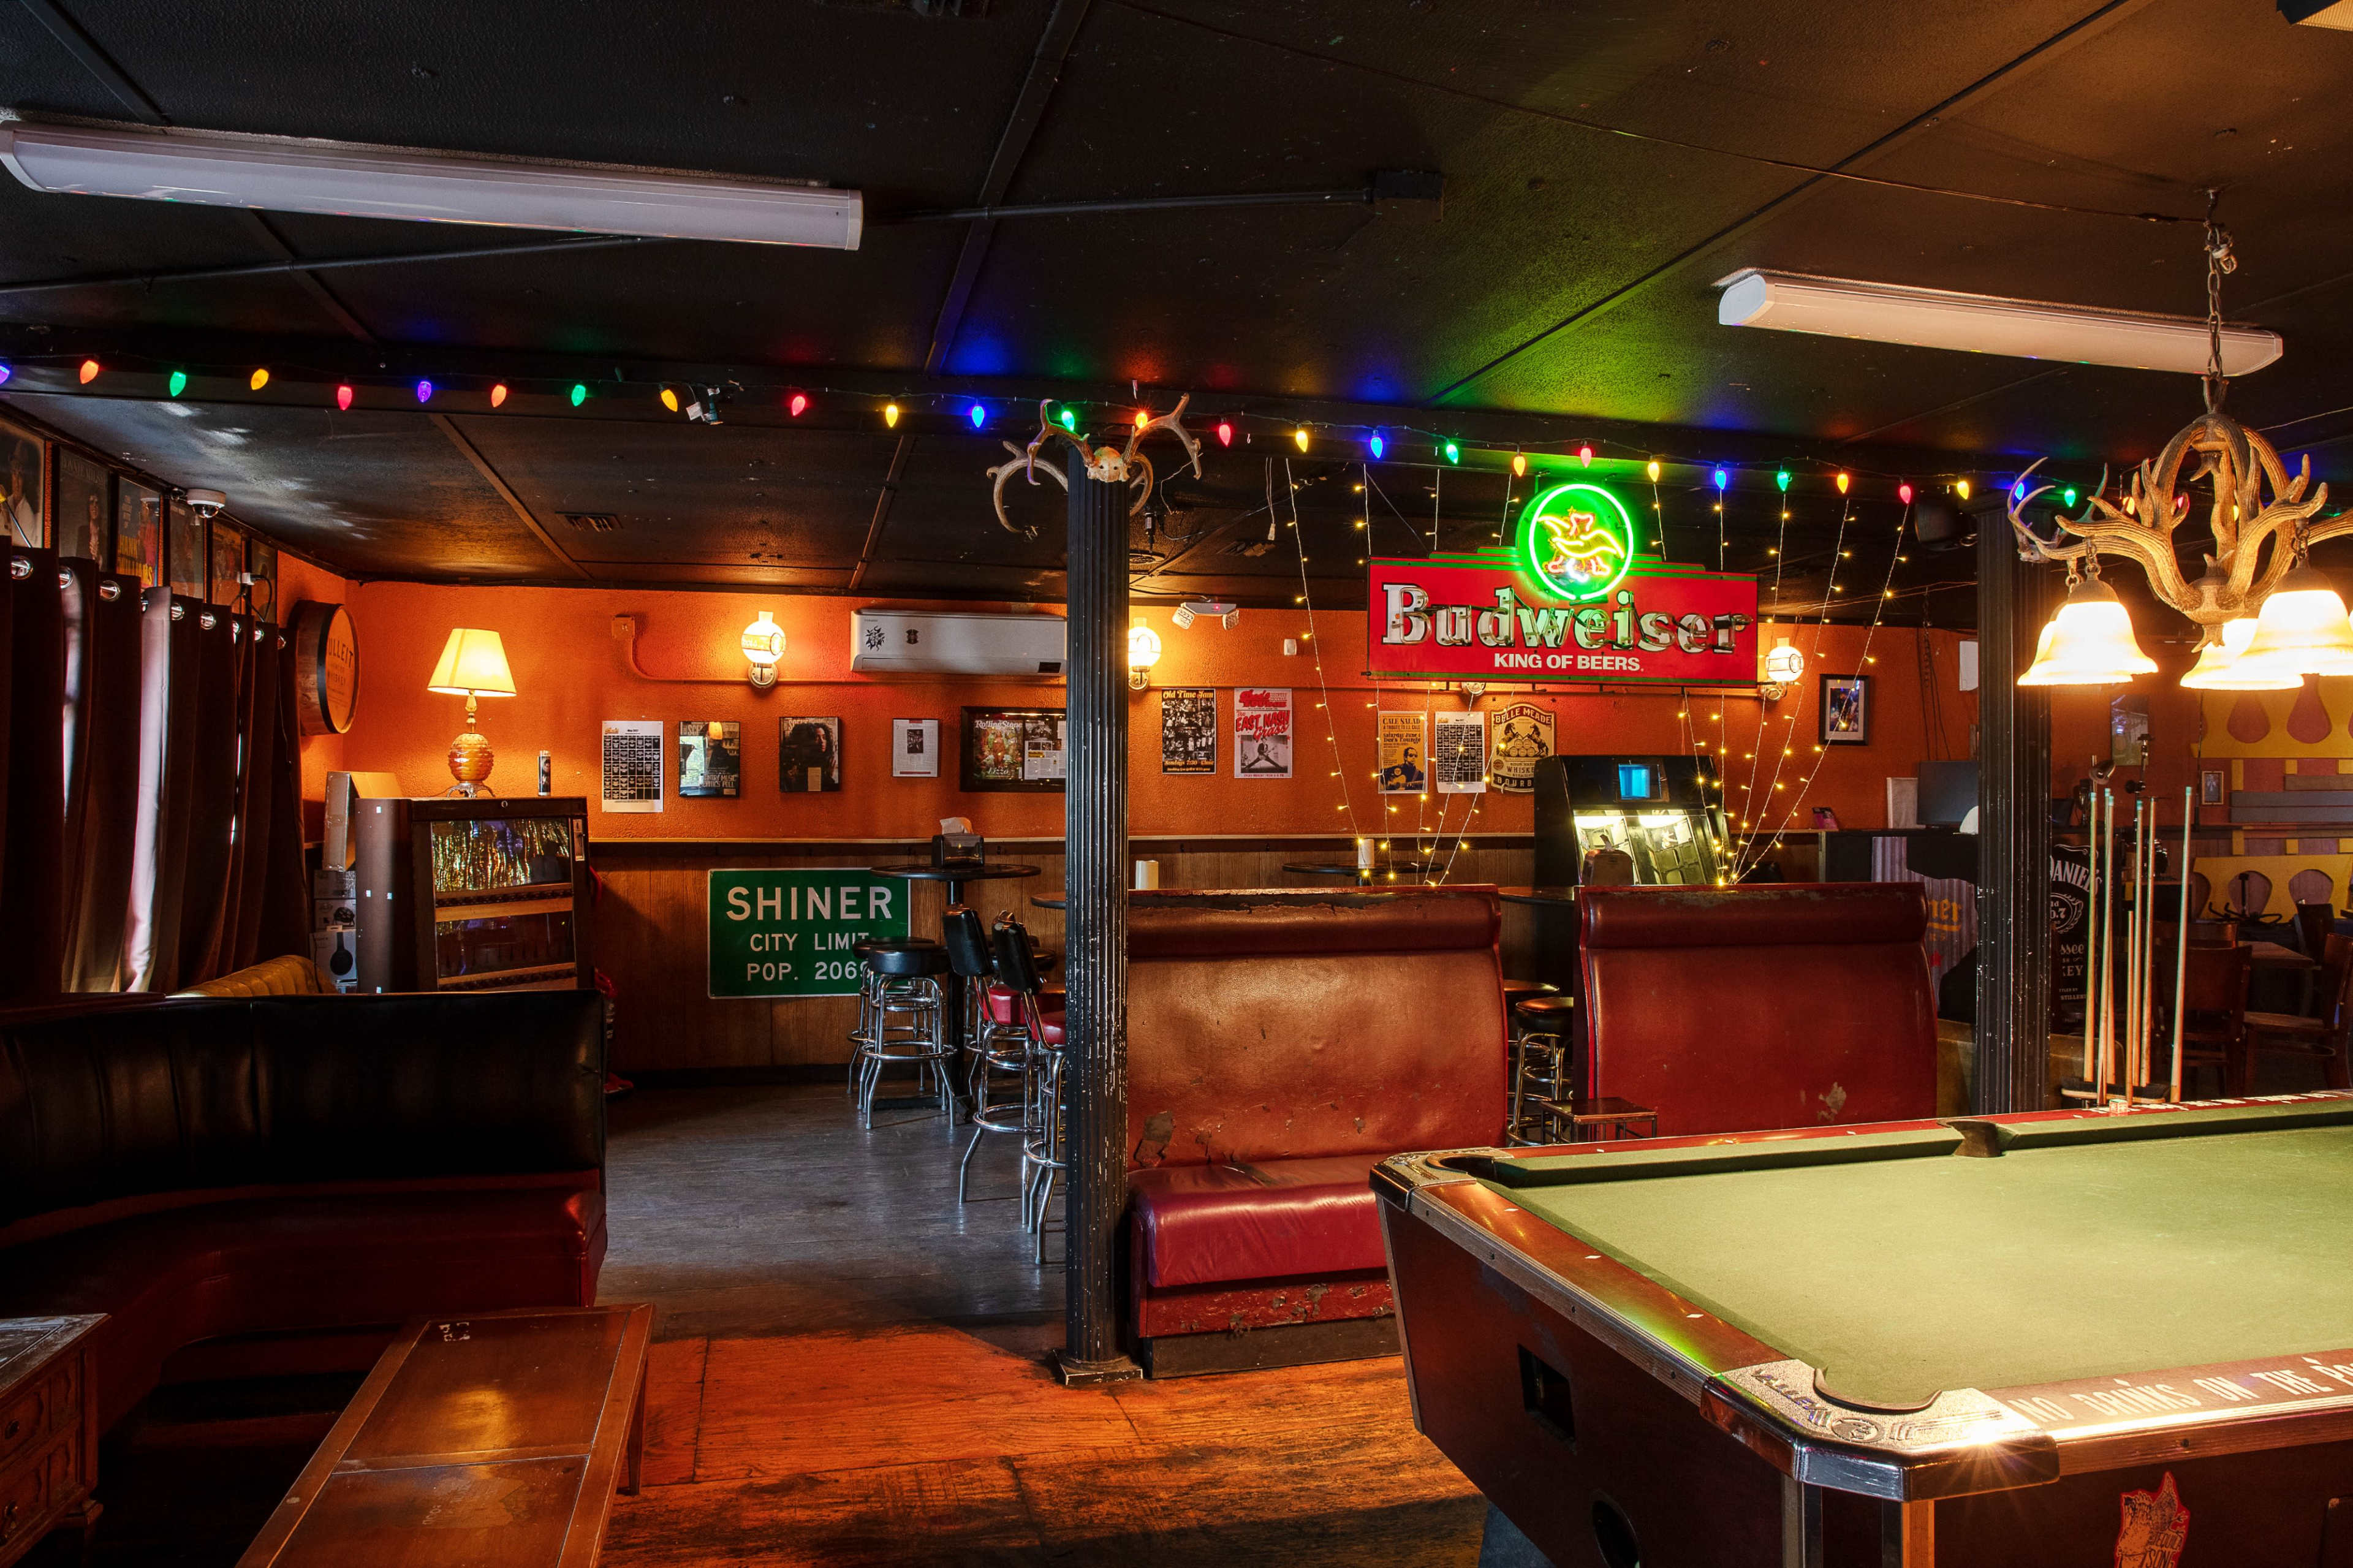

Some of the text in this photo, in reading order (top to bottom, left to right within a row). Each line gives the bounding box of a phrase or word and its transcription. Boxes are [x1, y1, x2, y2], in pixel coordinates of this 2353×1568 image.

[1382, 583, 1751, 653] Budweiser
[328, 638, 354, 668] ULLEIT
[1494, 653, 1542, 668] KING
[1546, 654, 1573, 669] OF
[1163, 690, 1214, 699] Old Time Jam
[1235, 710, 1290, 732] EAST NASH
[1495, 708, 1552, 724] BELLE MEADE
[1253, 724, 1290, 743] Grass
[726, 887, 892, 920] SHINER
[750, 933, 798, 952] CITY
[747, 963, 798, 981] POP.
[2008, 1397, 2074, 1422] NO
[2069, 1383, 2202, 1417] DRINKS
[2193, 1376, 2260, 1402] ON
[2248, 1369, 2335, 1395] THE
